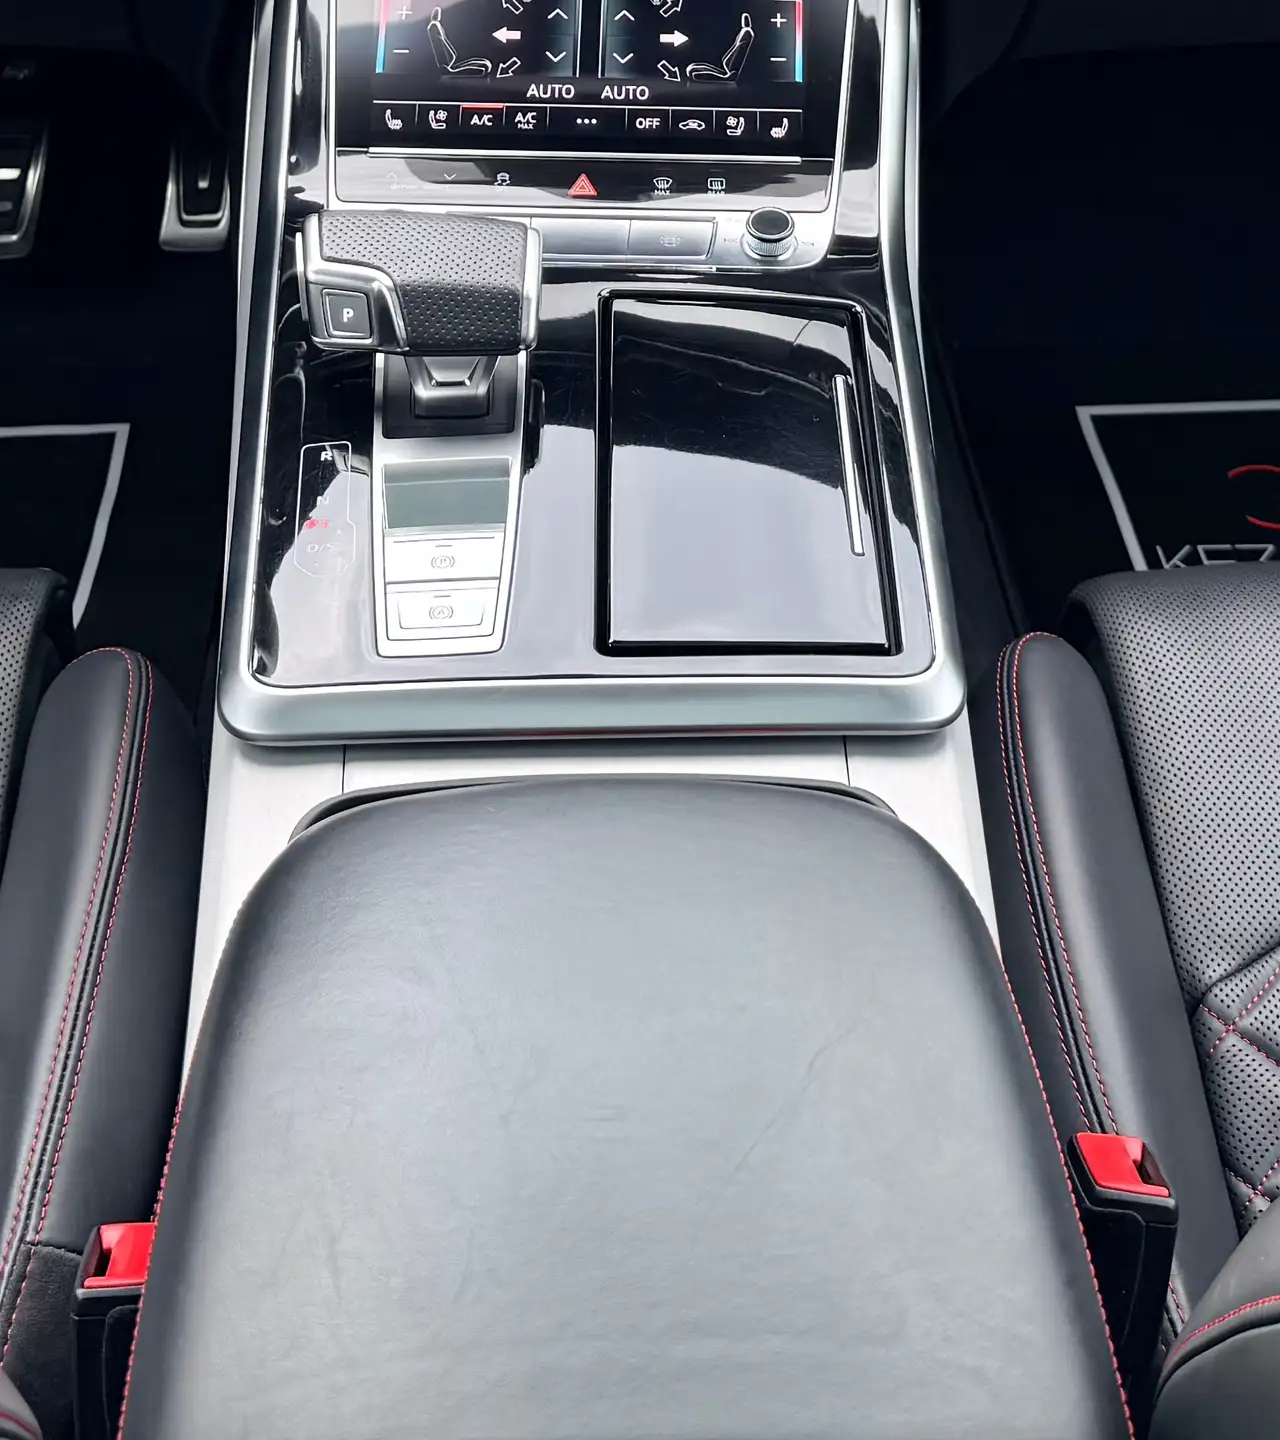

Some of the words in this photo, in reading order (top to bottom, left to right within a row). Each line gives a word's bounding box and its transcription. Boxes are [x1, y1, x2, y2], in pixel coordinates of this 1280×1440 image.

[526, 84, 575, 99] AUTO
[600, 85, 650, 100] AUTO
[470, 114, 493, 126] A/C
[514, 112, 537, 123] A/C
[635, 117, 661, 130] OFF
[342, 307, 354, 323] P
[320, 450, 333, 462] R
